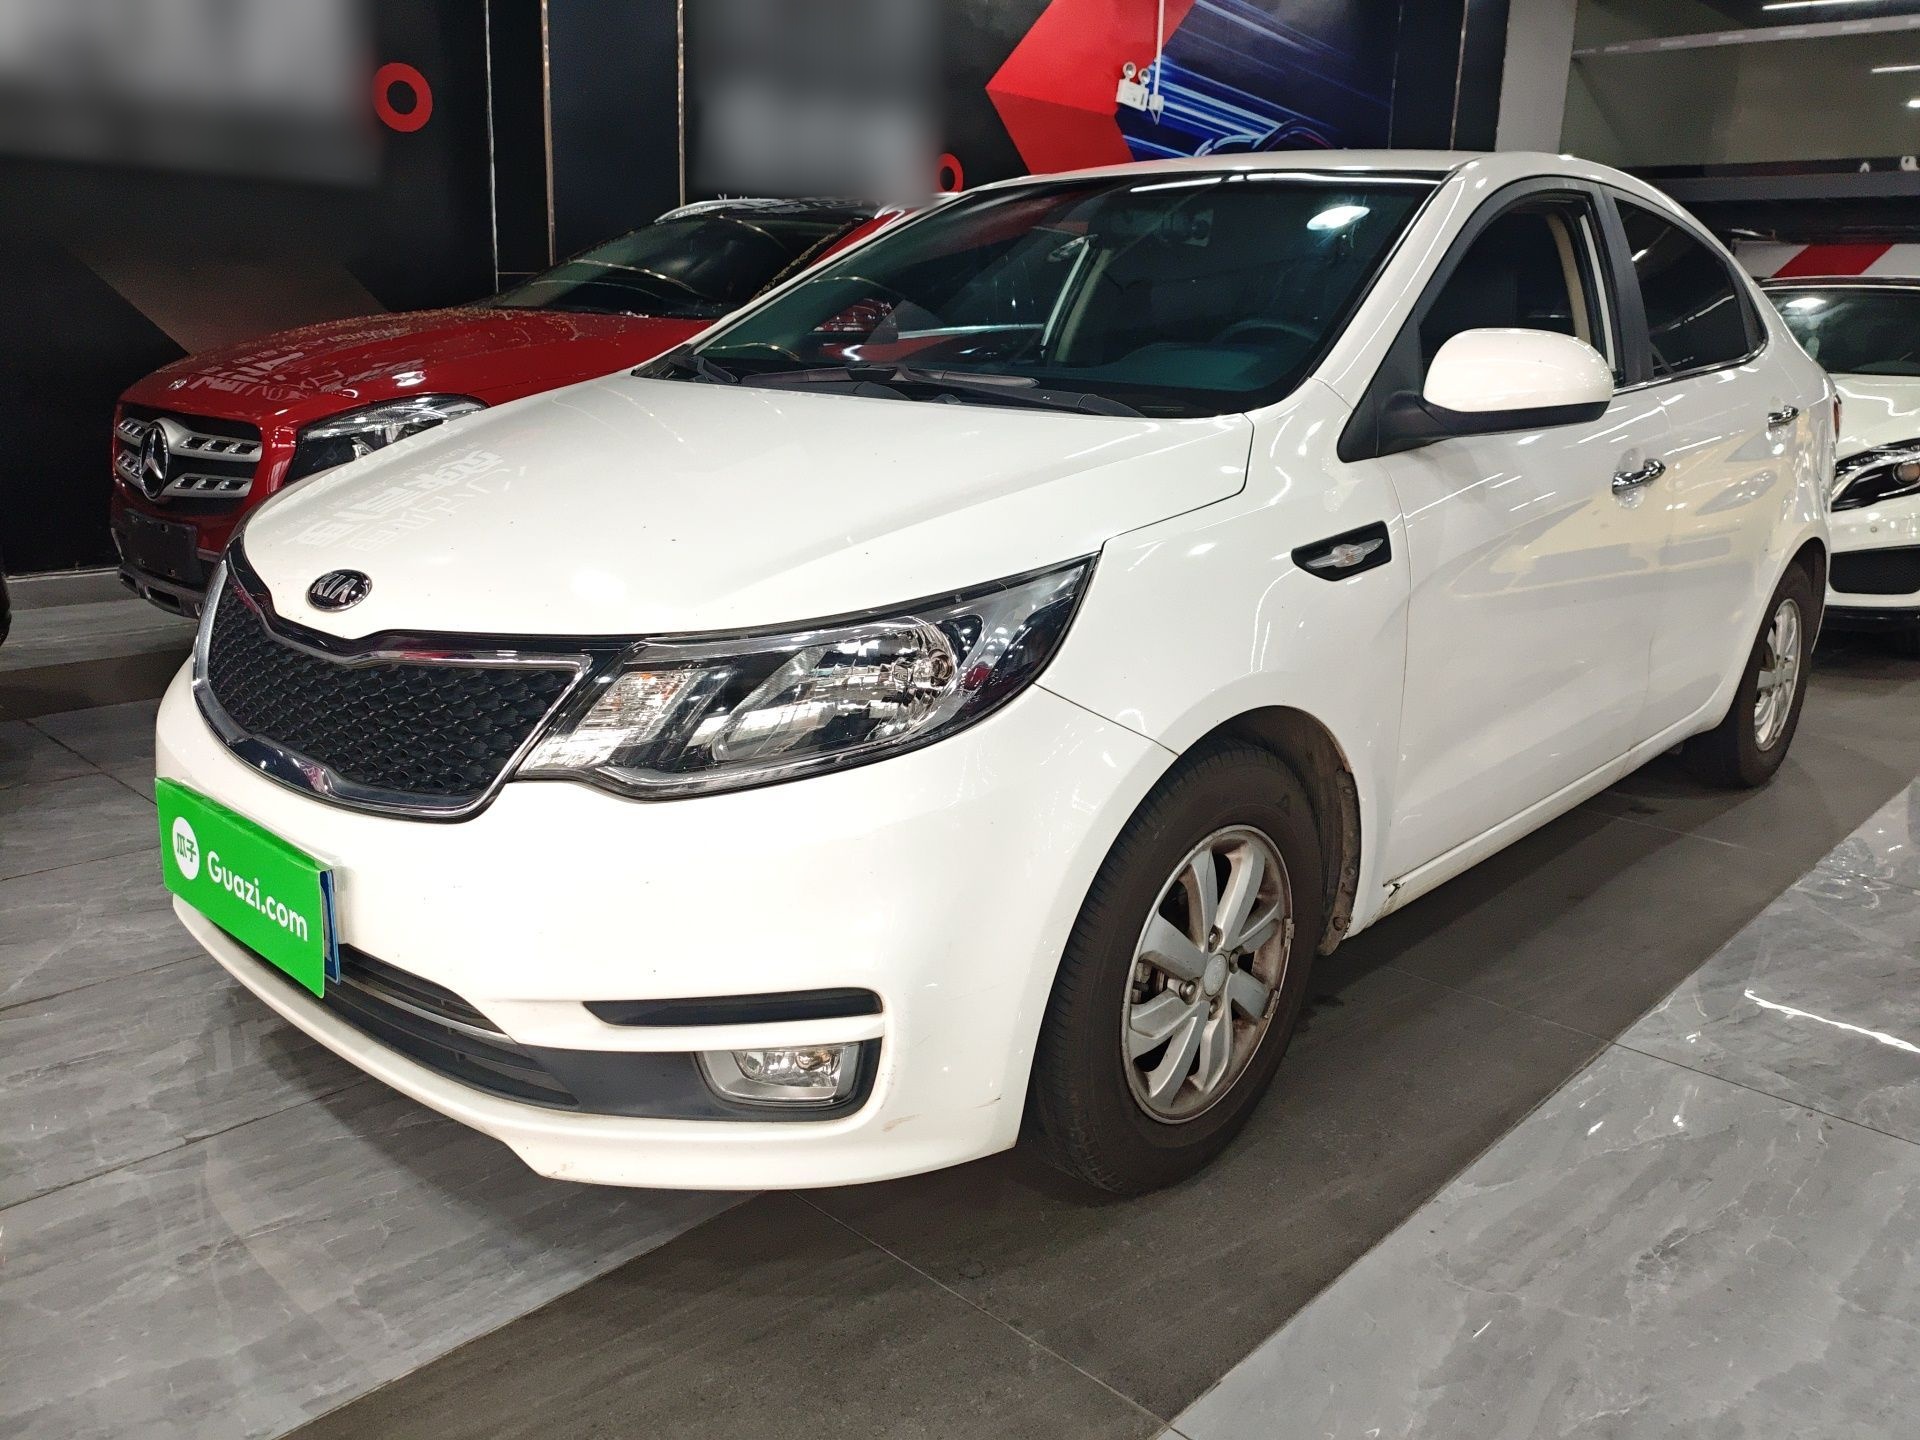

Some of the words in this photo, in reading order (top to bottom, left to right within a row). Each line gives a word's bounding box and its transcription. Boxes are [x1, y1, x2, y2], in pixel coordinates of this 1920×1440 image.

[311, 573, 358, 603] KIA
[176, 832, 197, 863] 瓜子
[207, 850, 308, 942] Guazi.com
